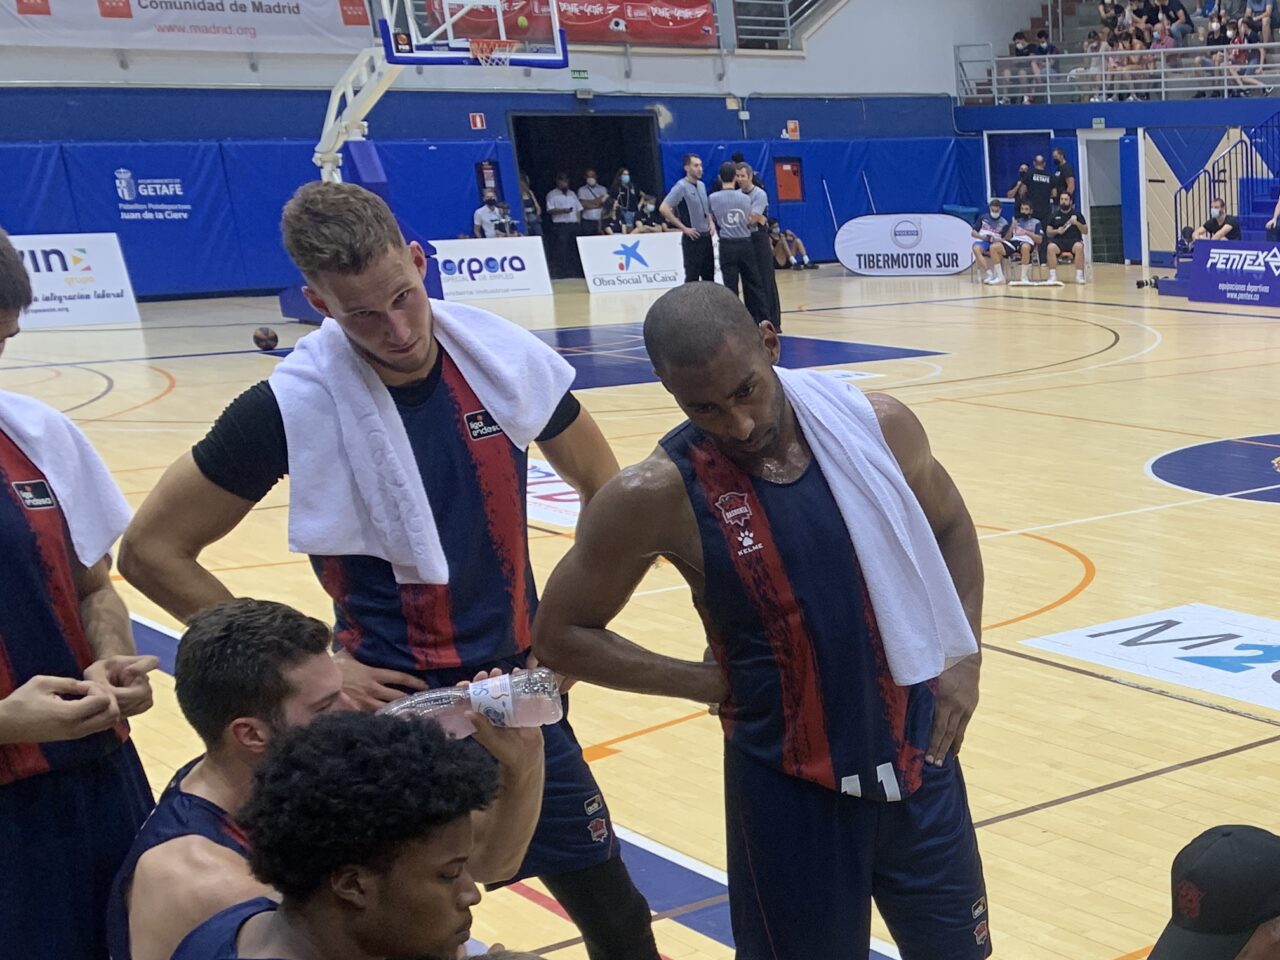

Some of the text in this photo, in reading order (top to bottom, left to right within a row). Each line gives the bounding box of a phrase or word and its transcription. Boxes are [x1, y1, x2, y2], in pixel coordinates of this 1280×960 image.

[230, 1, 247, 12] de
[252, 2, 300, 15] Madrid
[155, 24, 257, 38] www.madrid.org
[138, 184, 183, 196] GETAFE
[120, 211, 140, 219] Juan
[143, 211, 153, 219] de
[727, 212, 740, 223] 64
[856, 253, 959, 269] TIBERMOTOR SUR
[1206, 249, 1267, 271] PENTEX
[593, 276, 615, 287] Obra
[617, 275, 641, 286] Social
[737, 543, 764, 556] KELME
